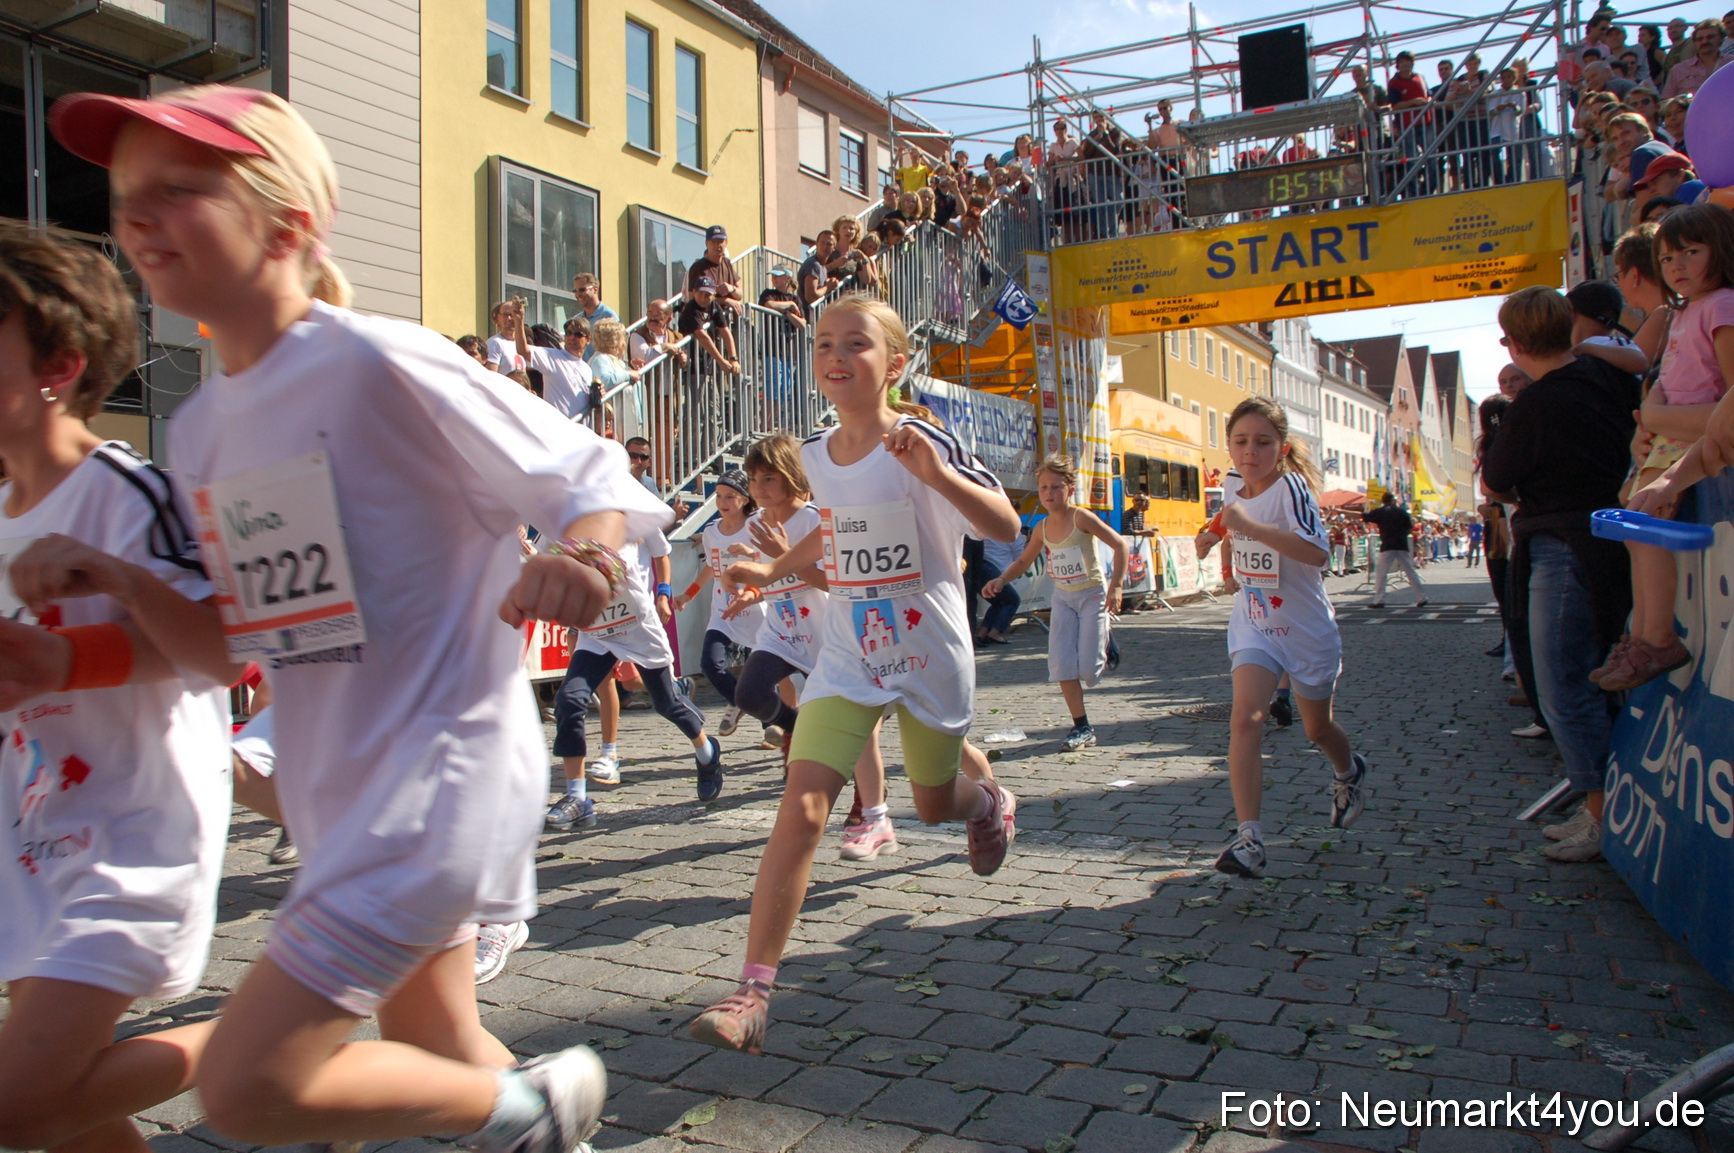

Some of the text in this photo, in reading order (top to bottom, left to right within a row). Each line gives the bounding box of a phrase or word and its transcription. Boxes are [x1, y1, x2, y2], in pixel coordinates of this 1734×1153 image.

[1413, 221, 1534, 247] Neumarkter Stadtlauf
[1206, 221, 1379, 280] START
[1078, 267, 1178, 287] Neumarkter Stadtlauf
[950, 398, 1040, 452] PFLEIDERER
[835, 516, 868, 533] Luisa
[840, 543, 913, 575] 7052
[1054, 562, 1083, 577] 7084
[1236, 550, 1273, 571] 7156
[233, 542, 338, 609] 7222
[600, 602, 630, 622] 172
